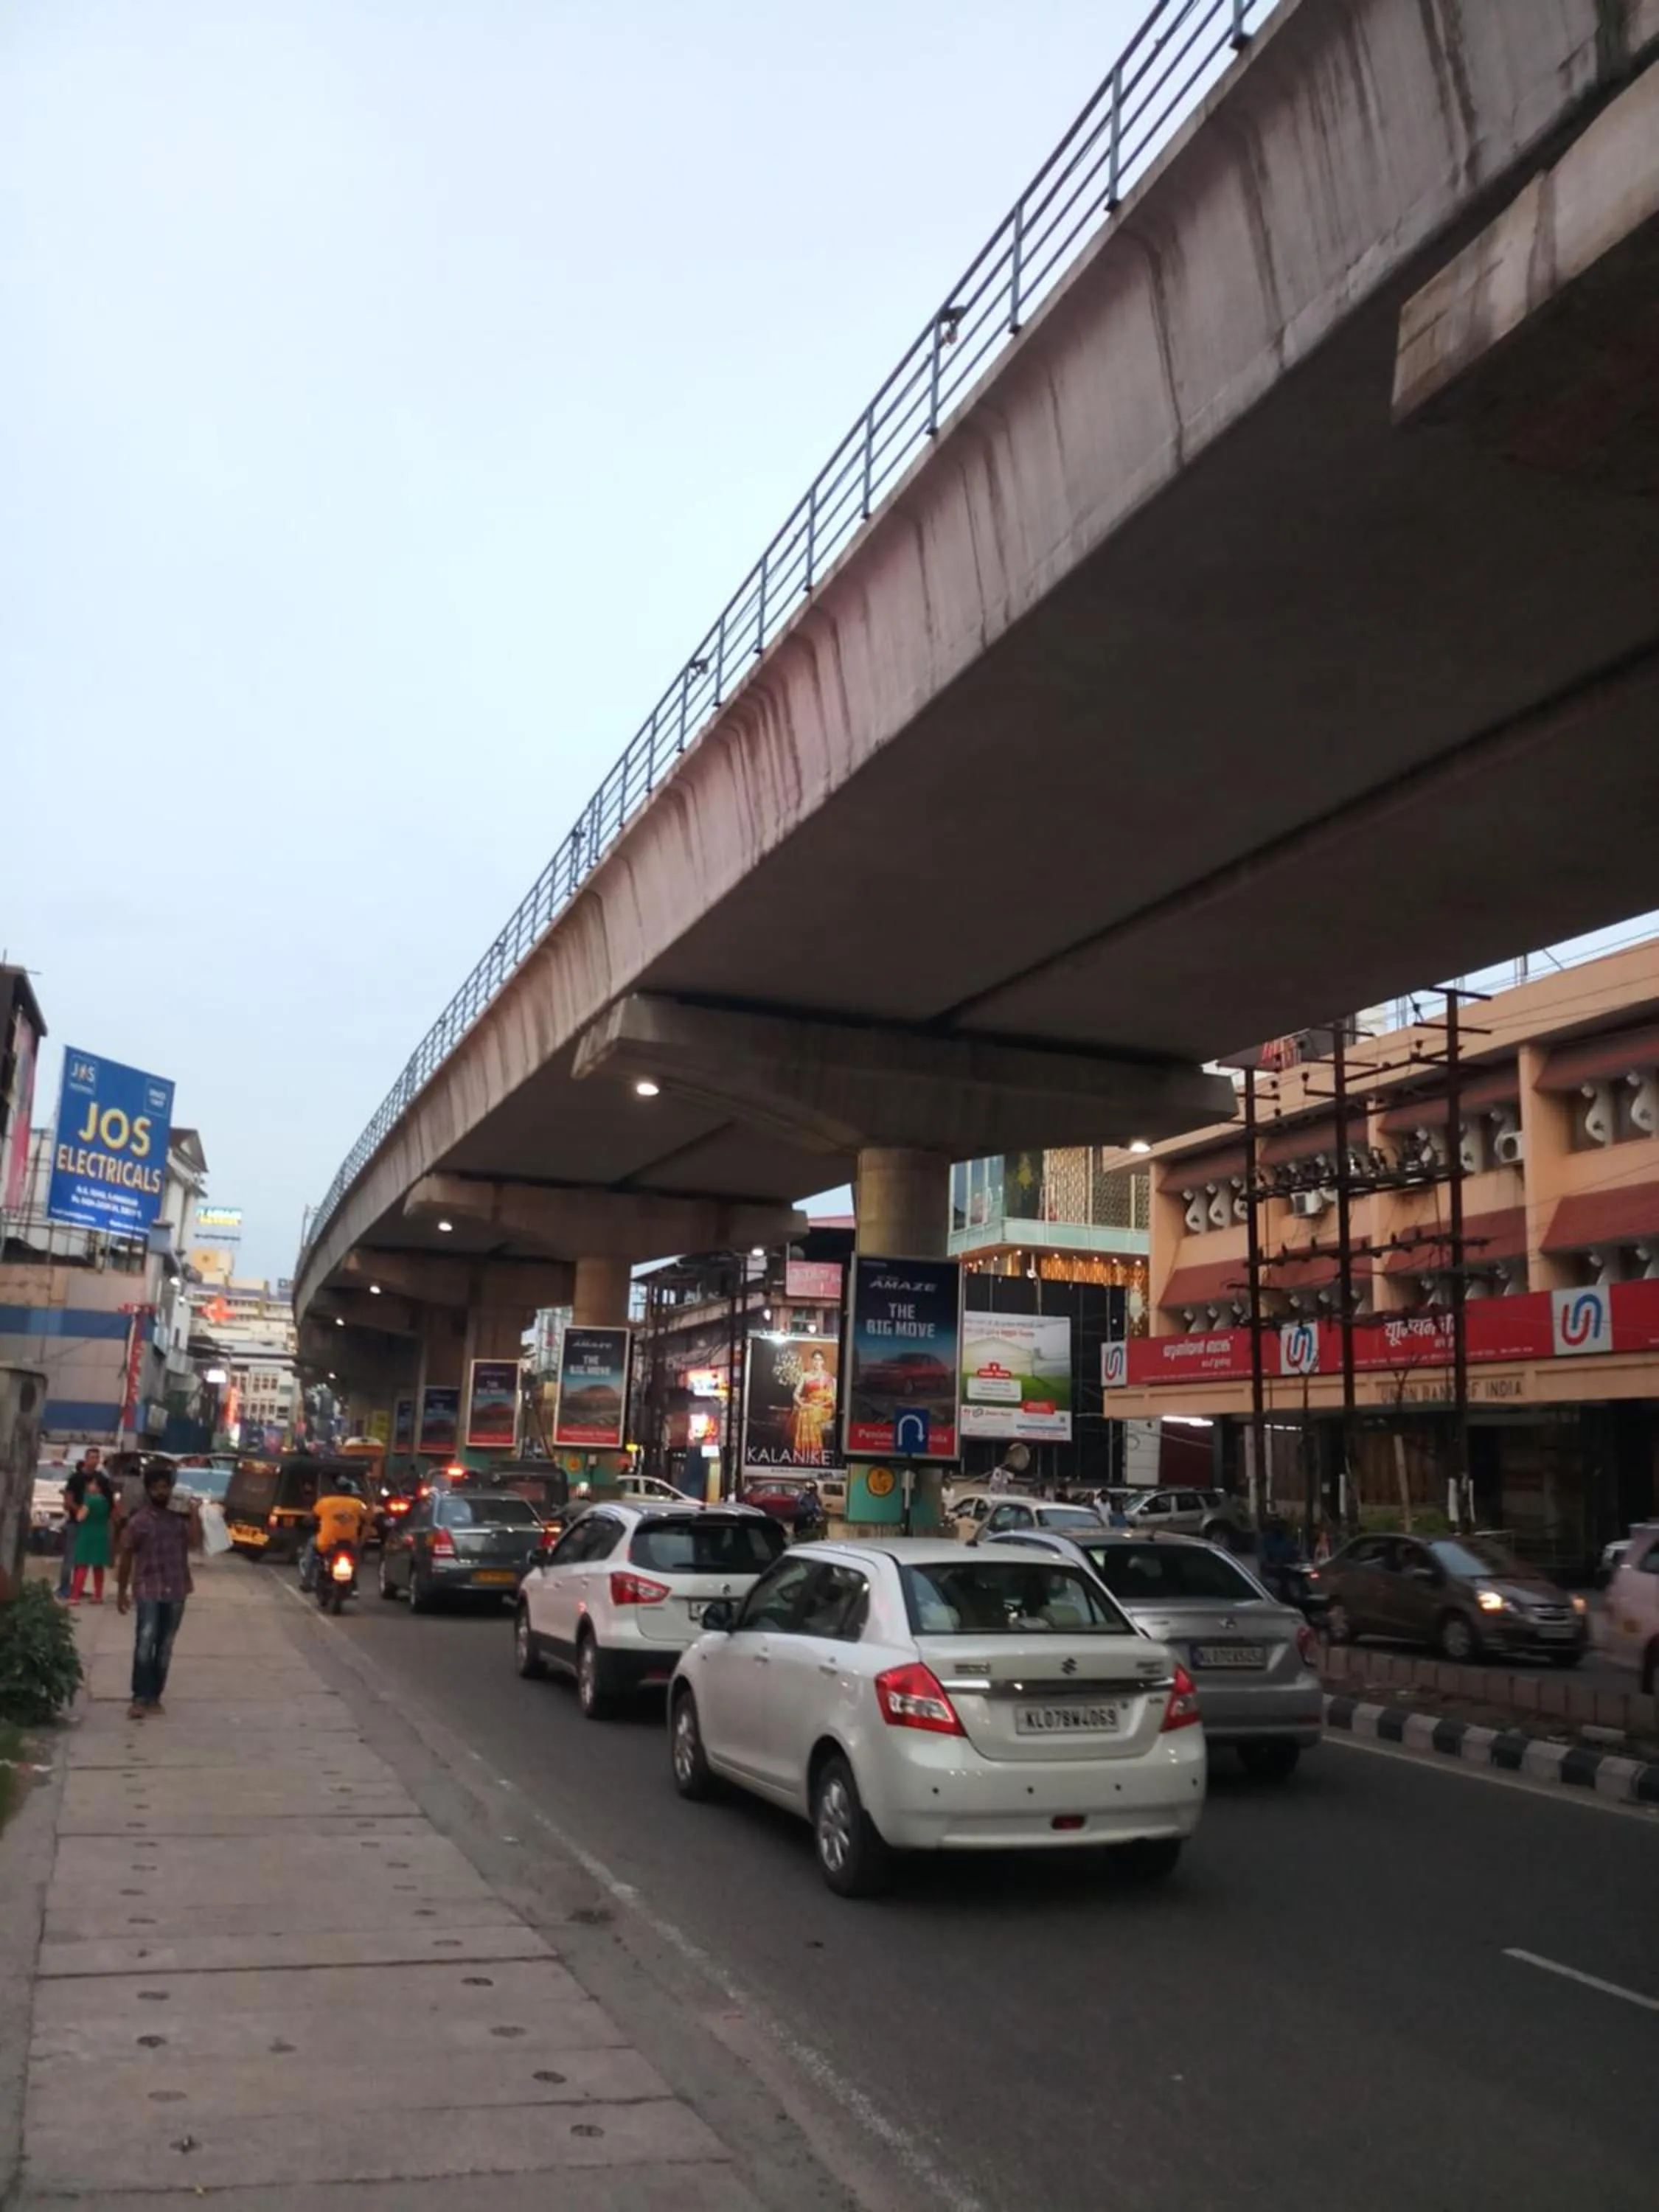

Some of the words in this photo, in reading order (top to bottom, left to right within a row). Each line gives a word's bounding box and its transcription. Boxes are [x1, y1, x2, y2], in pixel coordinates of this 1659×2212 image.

[78, 1102, 152, 1156] JOS
[57, 1144, 161, 1193] ELECTRICALS
[869, 1280, 937, 1293] AMAZE
[888, 1302, 917, 1319] THE
[866, 1318, 893, 1336] BIG
[896, 1321, 936, 1339] MOVE
[1485, 1380, 1523, 1399] INDIA
